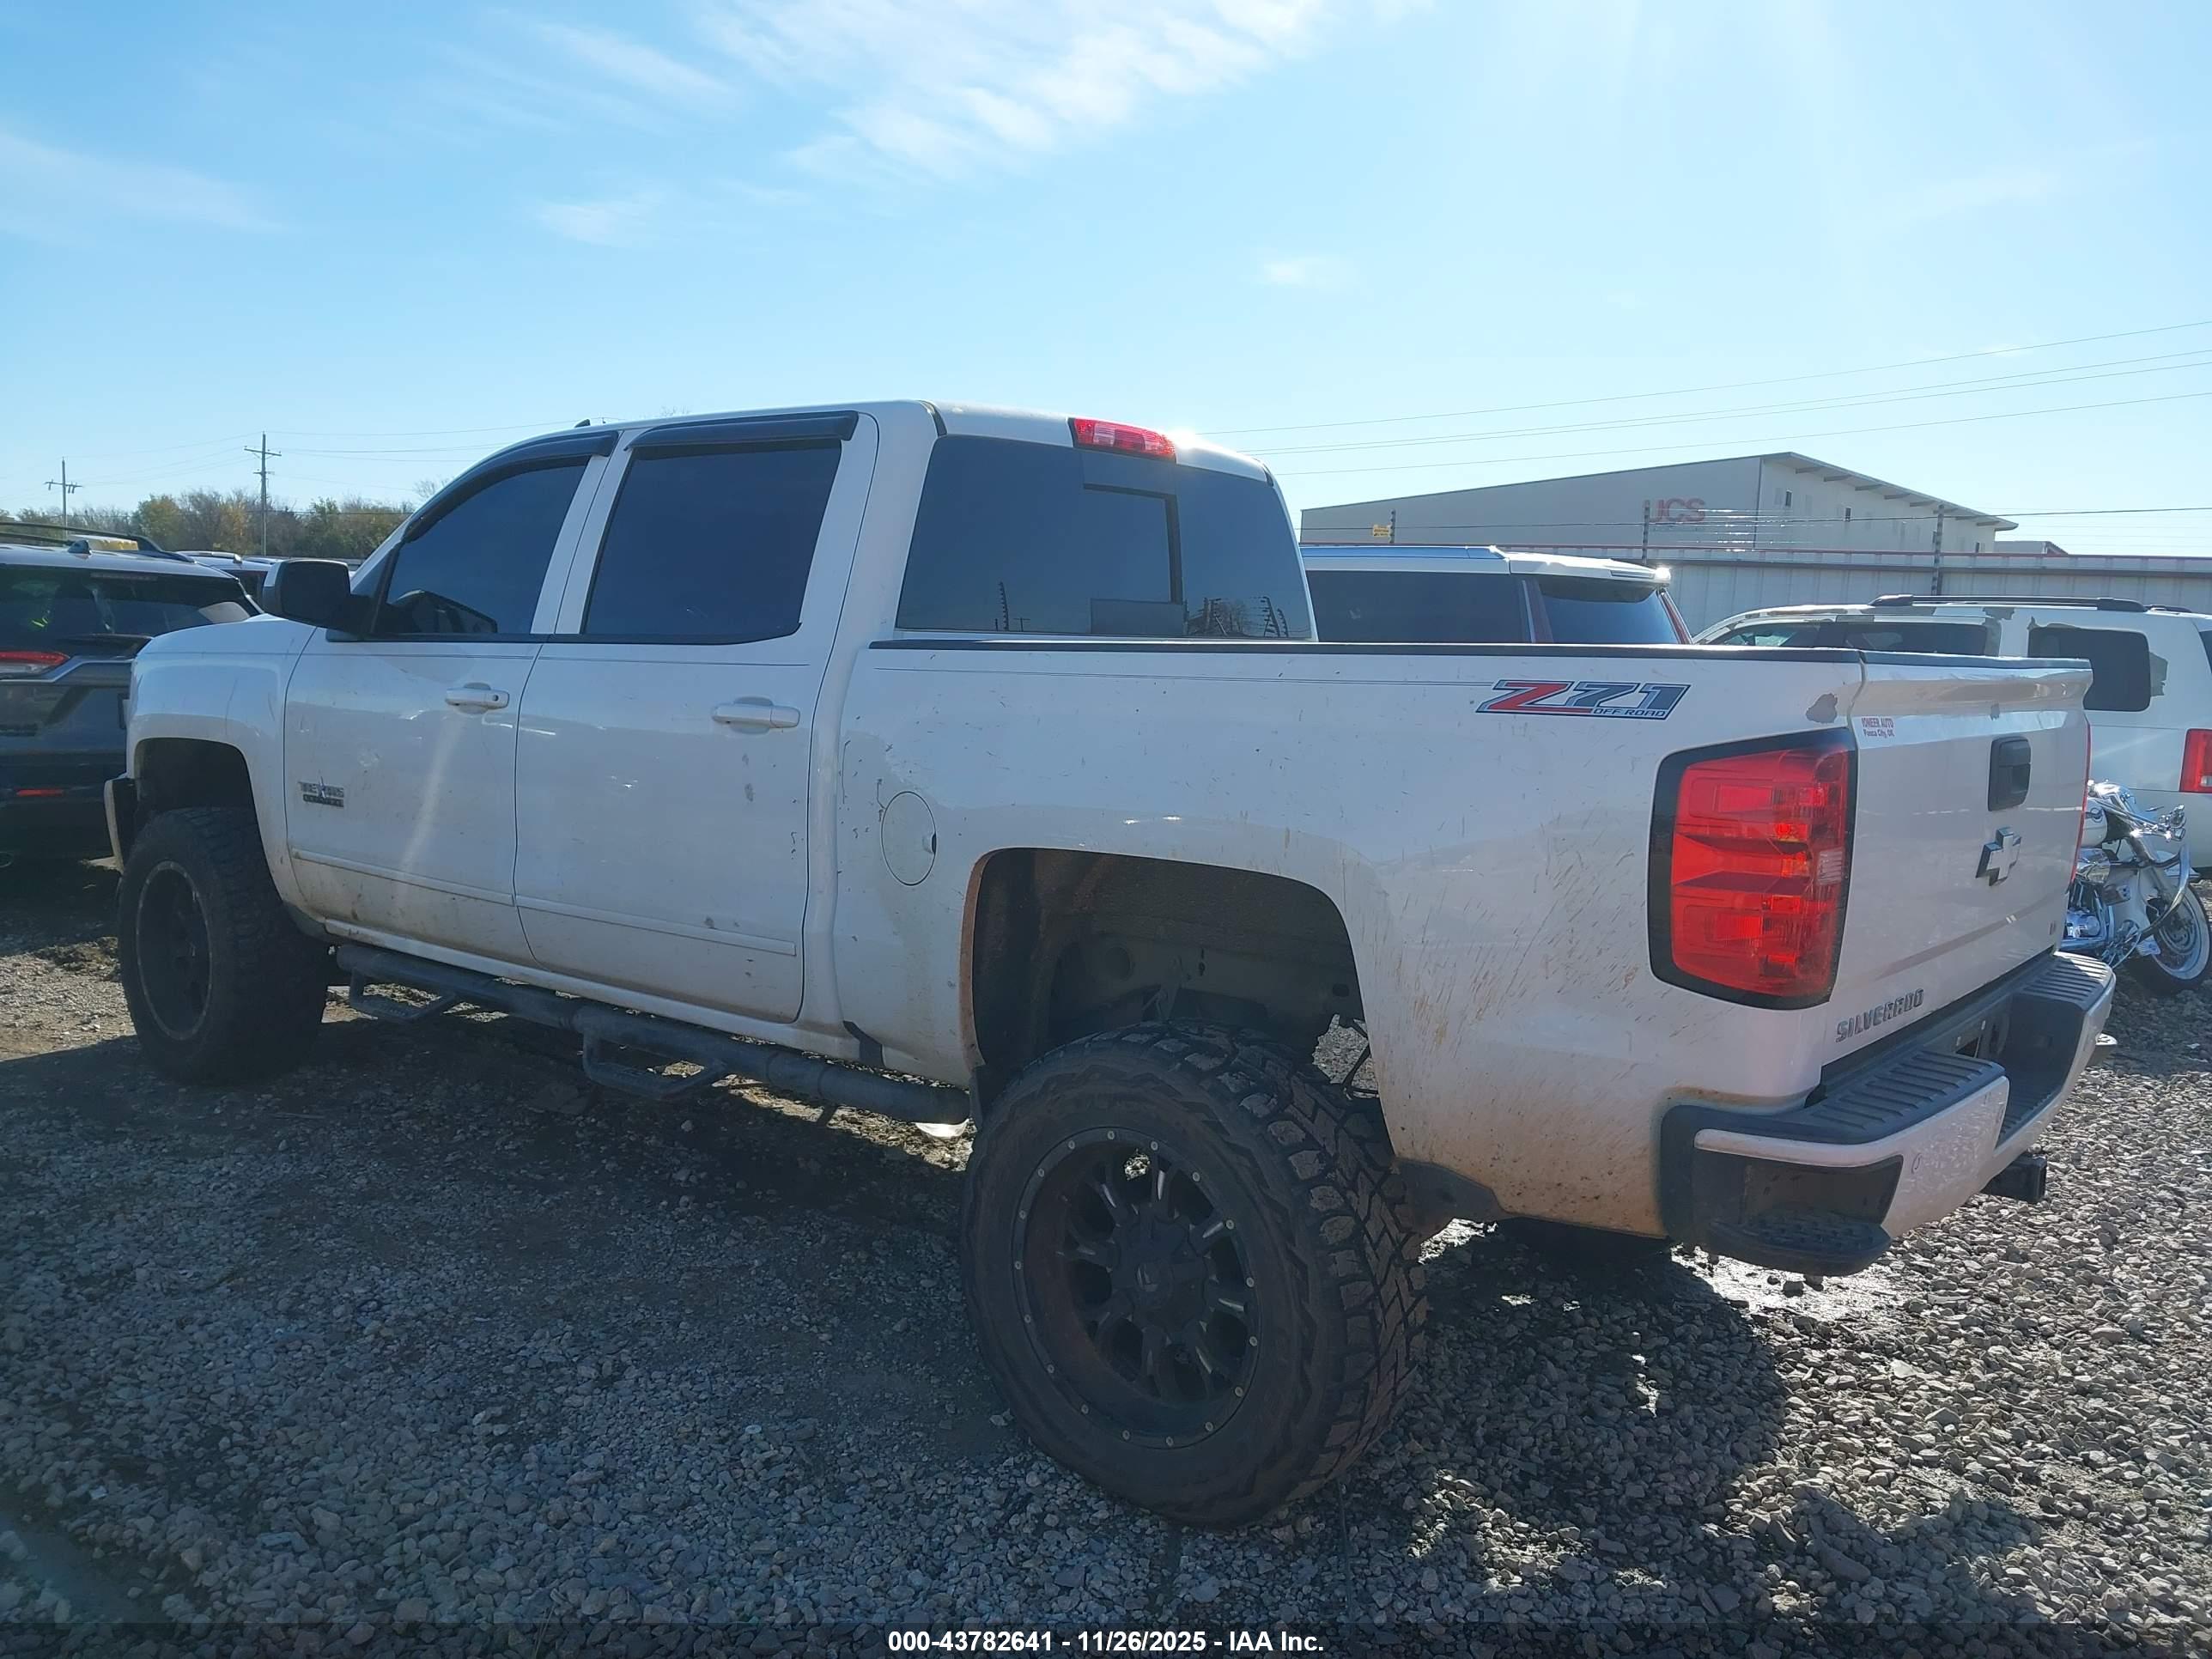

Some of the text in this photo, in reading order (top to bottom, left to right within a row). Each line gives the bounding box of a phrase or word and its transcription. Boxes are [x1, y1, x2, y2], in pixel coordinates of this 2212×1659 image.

[1475, 679, 1692, 719] Z71
[1624, 708, 1666, 717] ROAD
[1881, 717, 1894, 728] AUTO
[1835, 988, 1924, 1043] SILVERADO
